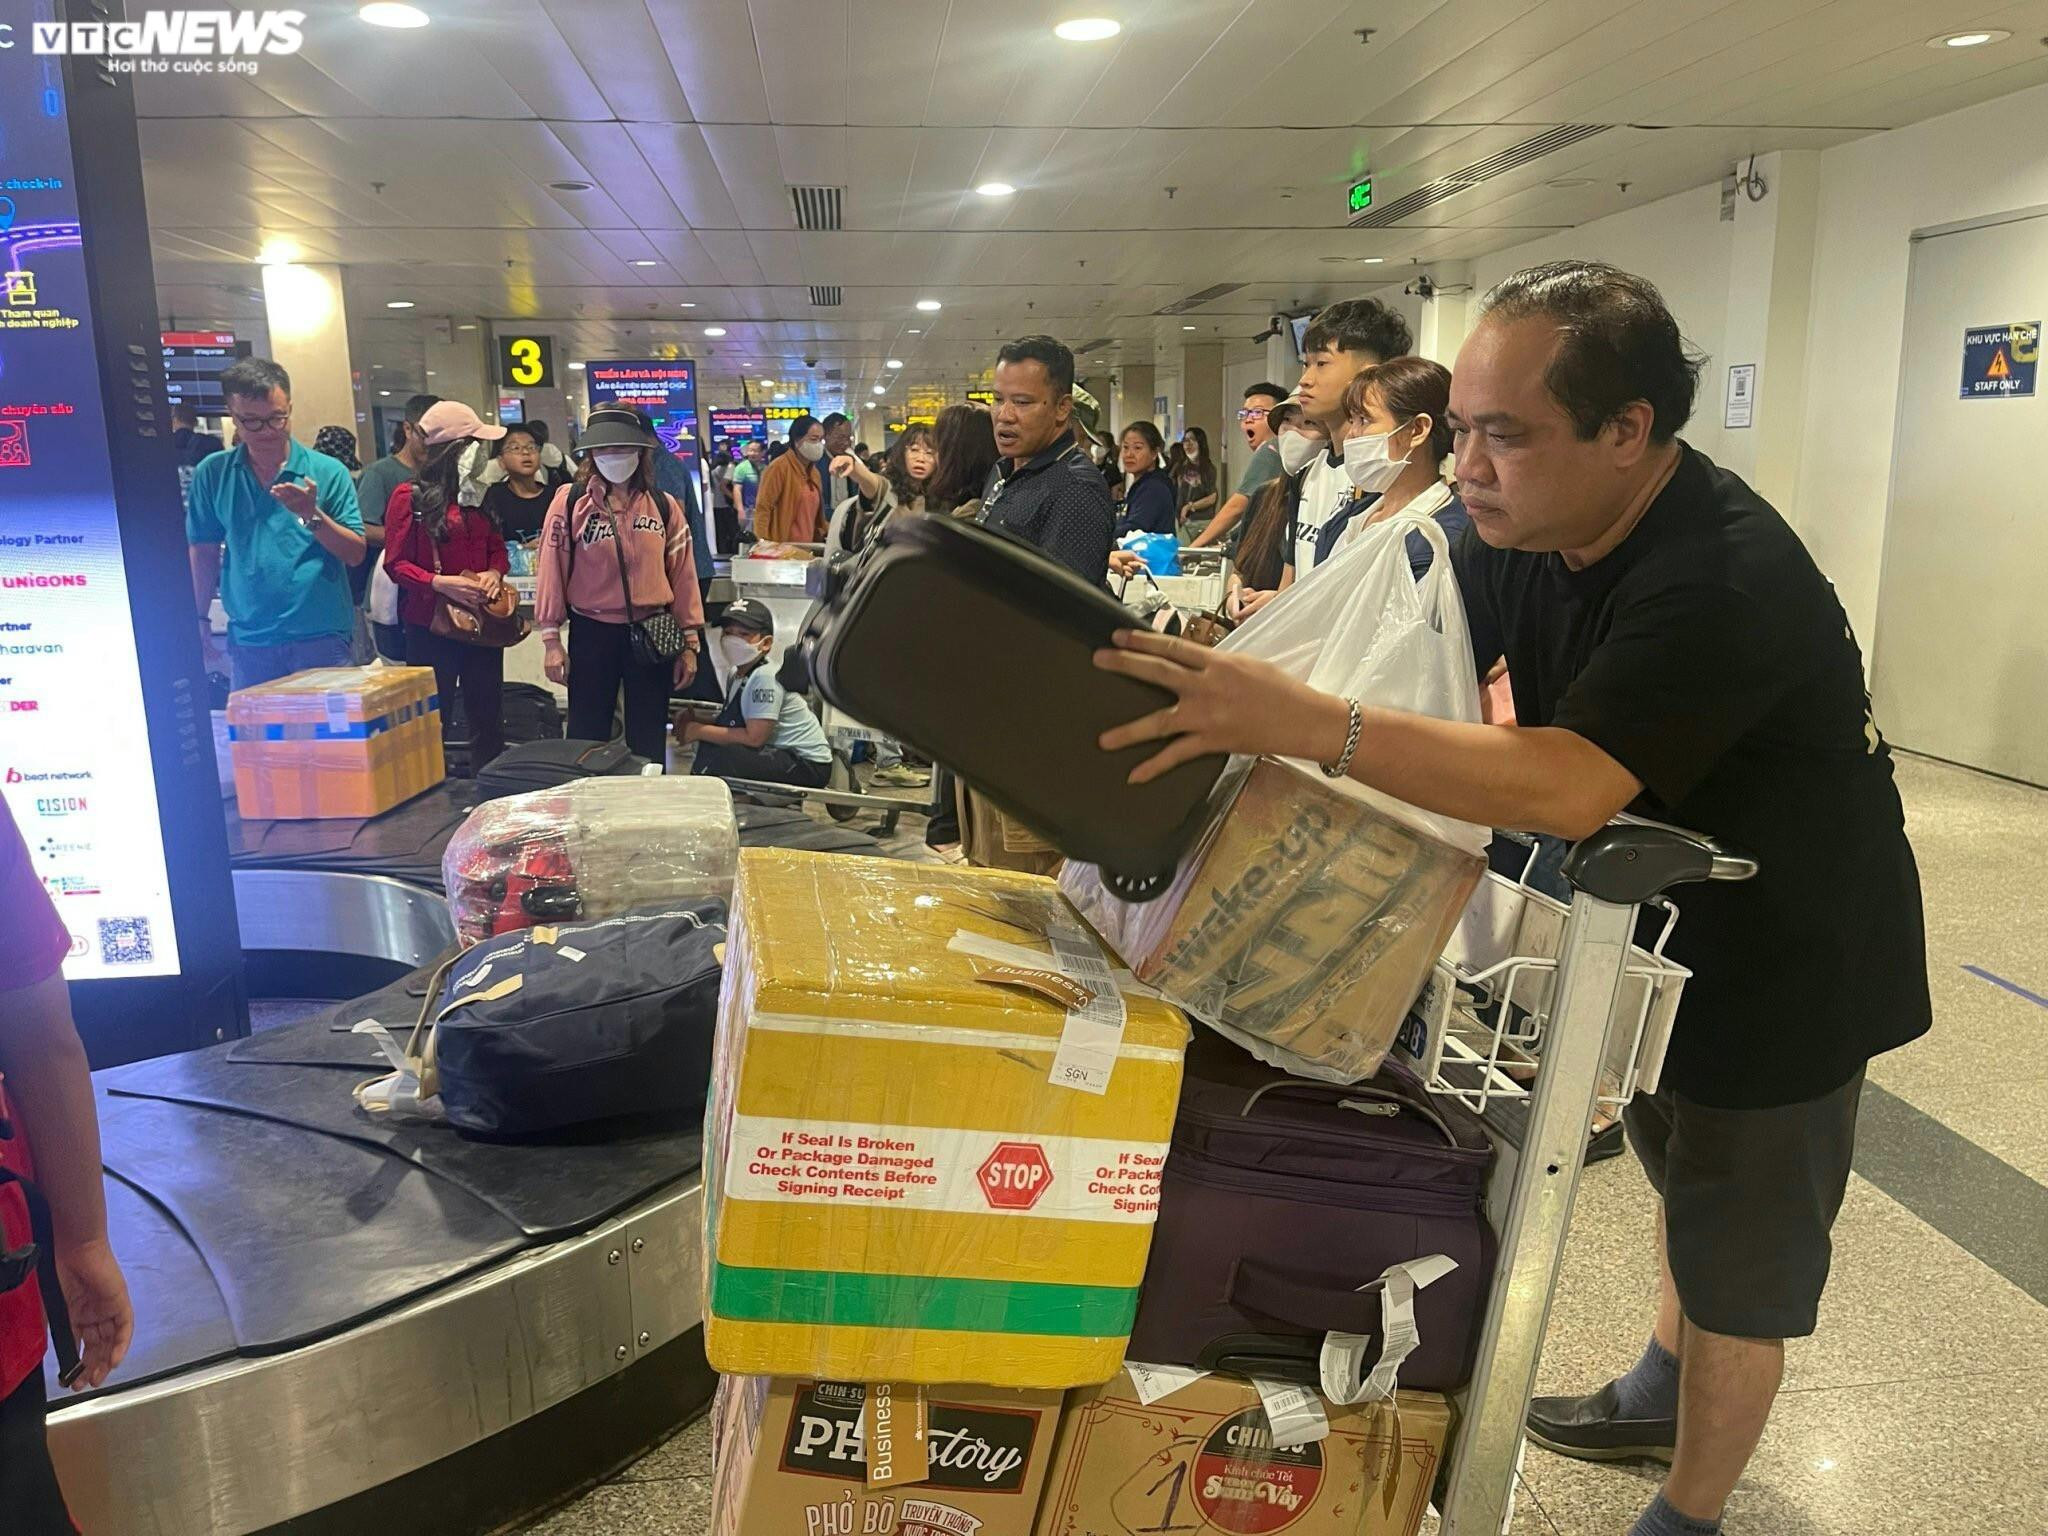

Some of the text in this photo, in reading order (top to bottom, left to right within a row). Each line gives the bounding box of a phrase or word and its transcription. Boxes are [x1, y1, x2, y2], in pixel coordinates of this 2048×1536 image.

[1, 310, 60, 320] Tham quan
[7, 320, 40, 328] doanh
[1966, 334, 1983, 345] KHU
[511, 339, 543, 385] 3
[1975, 379, 2021, 391] STAFF ONLY
[35, 535, 84, 544] Partner
[37, 798, 87, 812] CISION
[1065, 1067, 1088, 1081] SGN
[781, 1132, 915, 1151] If Seal Is Broken
[757, 1146, 934, 1169] Or Package Damaged
[1119, 1153, 1164, 1166] If Seal
[749, 1162, 937, 1185] Check Contents Before
[987, 1161, 1043, 1190] STOP
[1096, 1167, 1115, 1179] Or
[777, 1180, 906, 1200] Signing Receipt
[1088, 1182, 1135, 1195] Check
[1113, 1198, 1160, 1213] Signin
[874, 1384, 893, 1480] Business
